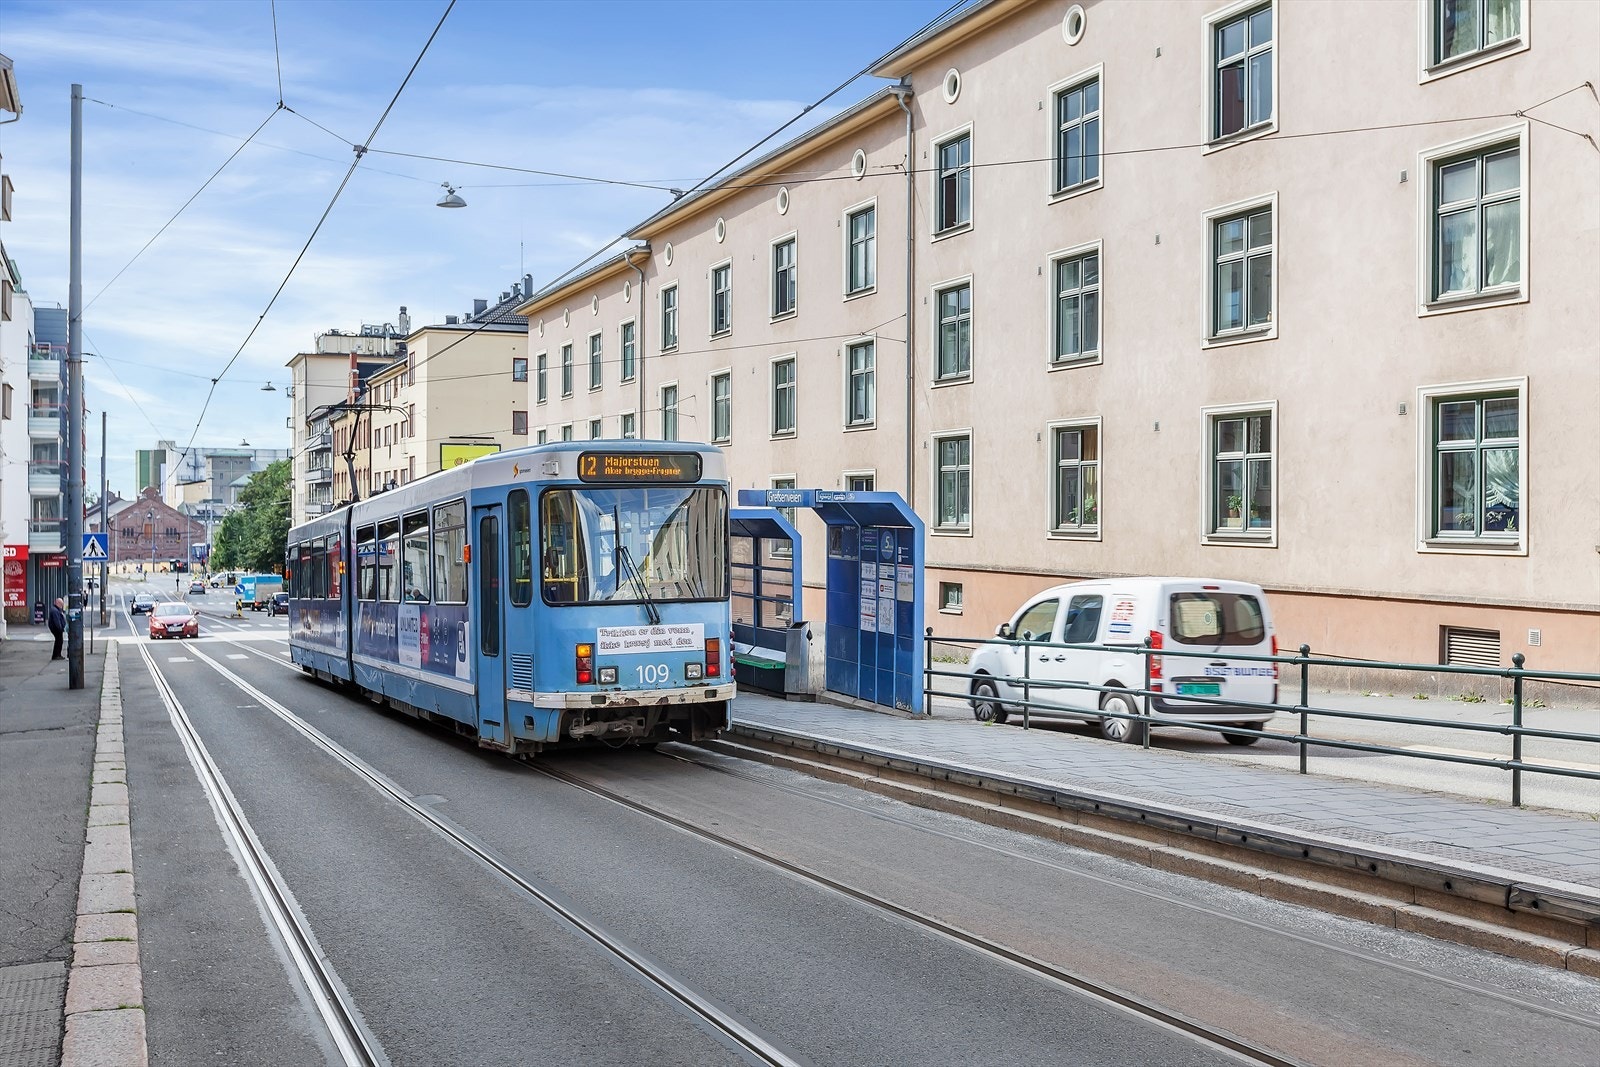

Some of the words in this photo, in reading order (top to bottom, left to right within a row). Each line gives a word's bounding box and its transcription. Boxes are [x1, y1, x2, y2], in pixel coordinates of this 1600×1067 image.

[580, 456, 597, 476] 12
[605, 456, 659, 467] Majorstuen
[604, 467, 622, 475] Aker
[638, 628, 649, 636] er
[650, 626, 666, 636] din
[600, 640, 621, 650] ikke
[653, 637, 673, 647] med
[675, 637, 693, 646] den
[635, 663, 669, 684] 109
